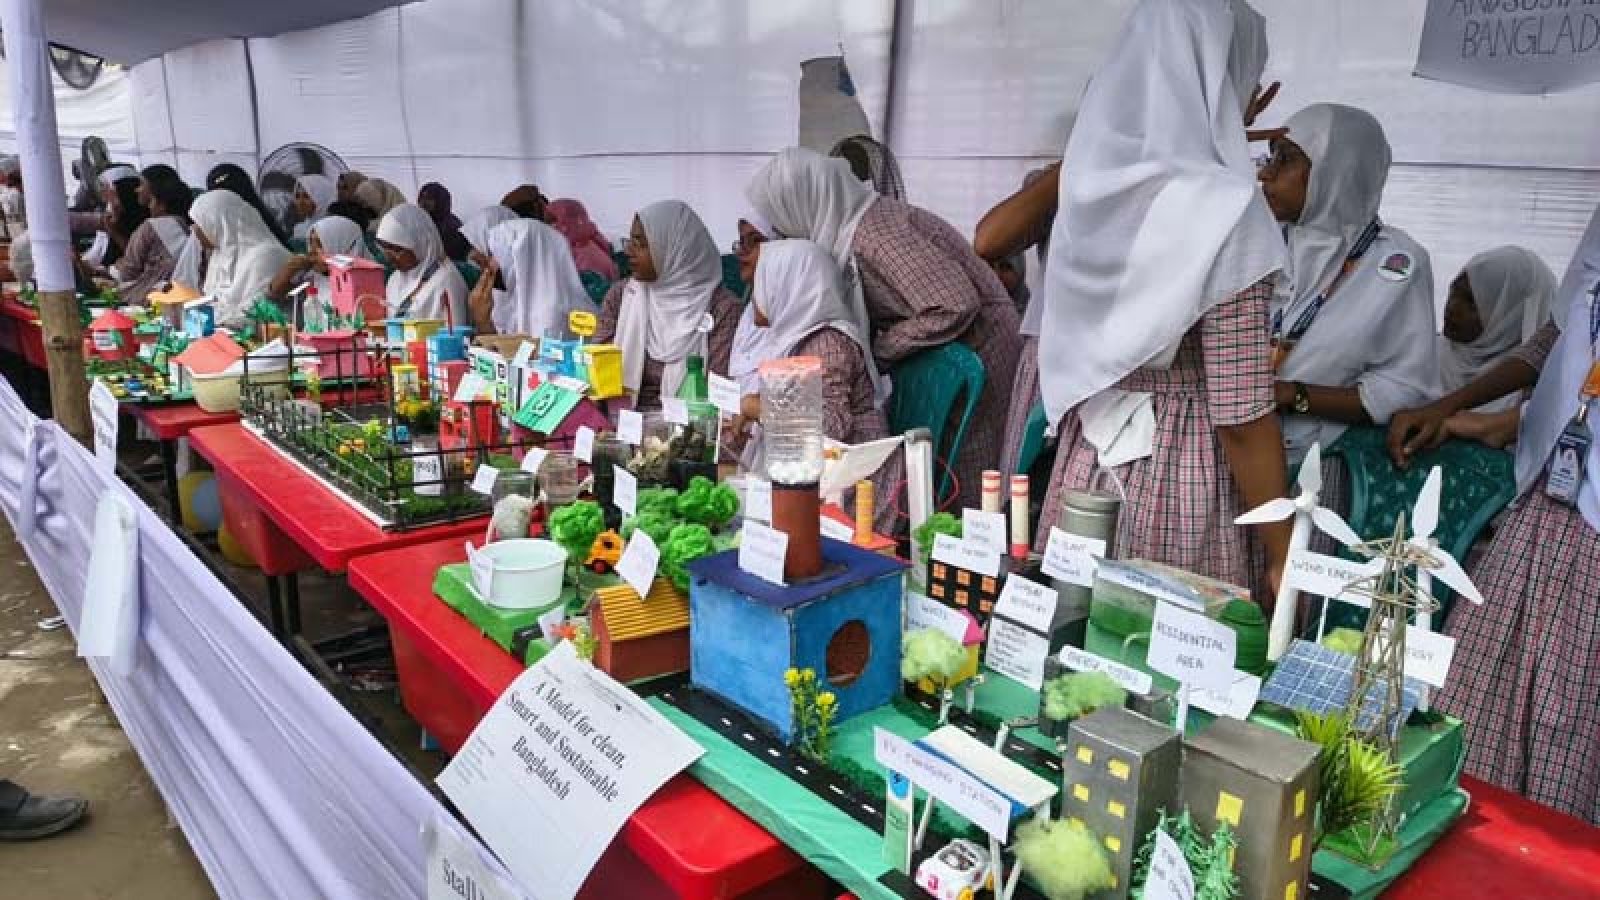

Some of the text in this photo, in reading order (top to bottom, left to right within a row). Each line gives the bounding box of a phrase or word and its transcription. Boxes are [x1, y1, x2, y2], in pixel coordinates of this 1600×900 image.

[1156, 621, 1226, 652] RESIDENTIAL
[1176, 654, 1204, 670] AREA
[506, 690, 540, 726] Smart
[534, 722, 560, 744] and
[553, 736, 619, 802] Sustainable
[532, 681, 546, 695] A
[541, 687, 582, 723] Model
[574, 716, 597, 736] for
[591, 735, 625, 770] clean,
[512, 736, 571, 800] Bangladesh
[443, 858, 477, 900] Stall
